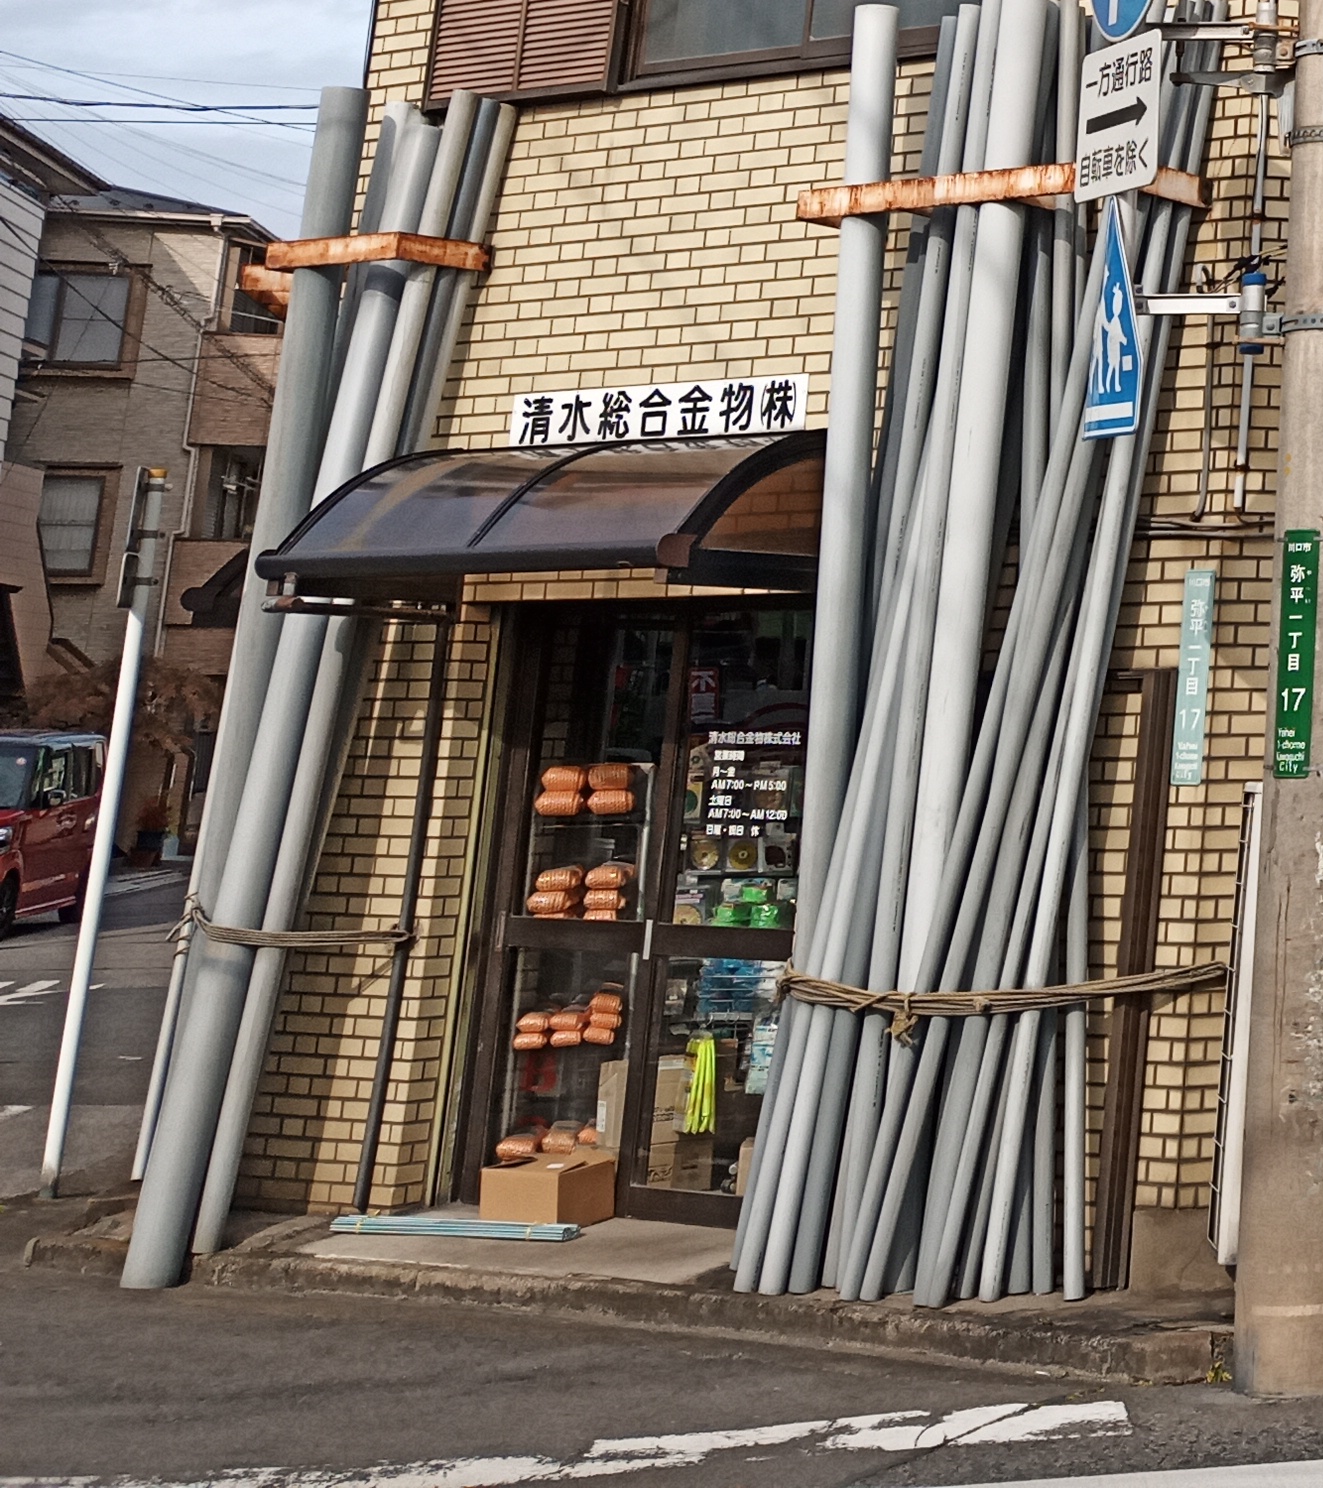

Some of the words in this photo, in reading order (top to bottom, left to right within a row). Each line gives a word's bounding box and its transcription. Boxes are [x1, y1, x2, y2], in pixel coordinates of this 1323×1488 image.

[1085, 46, 1153, 98] 一方通行路
[1079, 136, 1149, 188] 自転車を除く
[1288, 542, 1312, 553] 川口市
[1287, 564, 1306, 672] 弥平一丁目
[1185, 598, 1206, 696] 弥平一丁目
[1179, 708, 1201, 730] 17
[1281, 688, 1306, 712] 17
[1279, 760, 1298, 774] City
